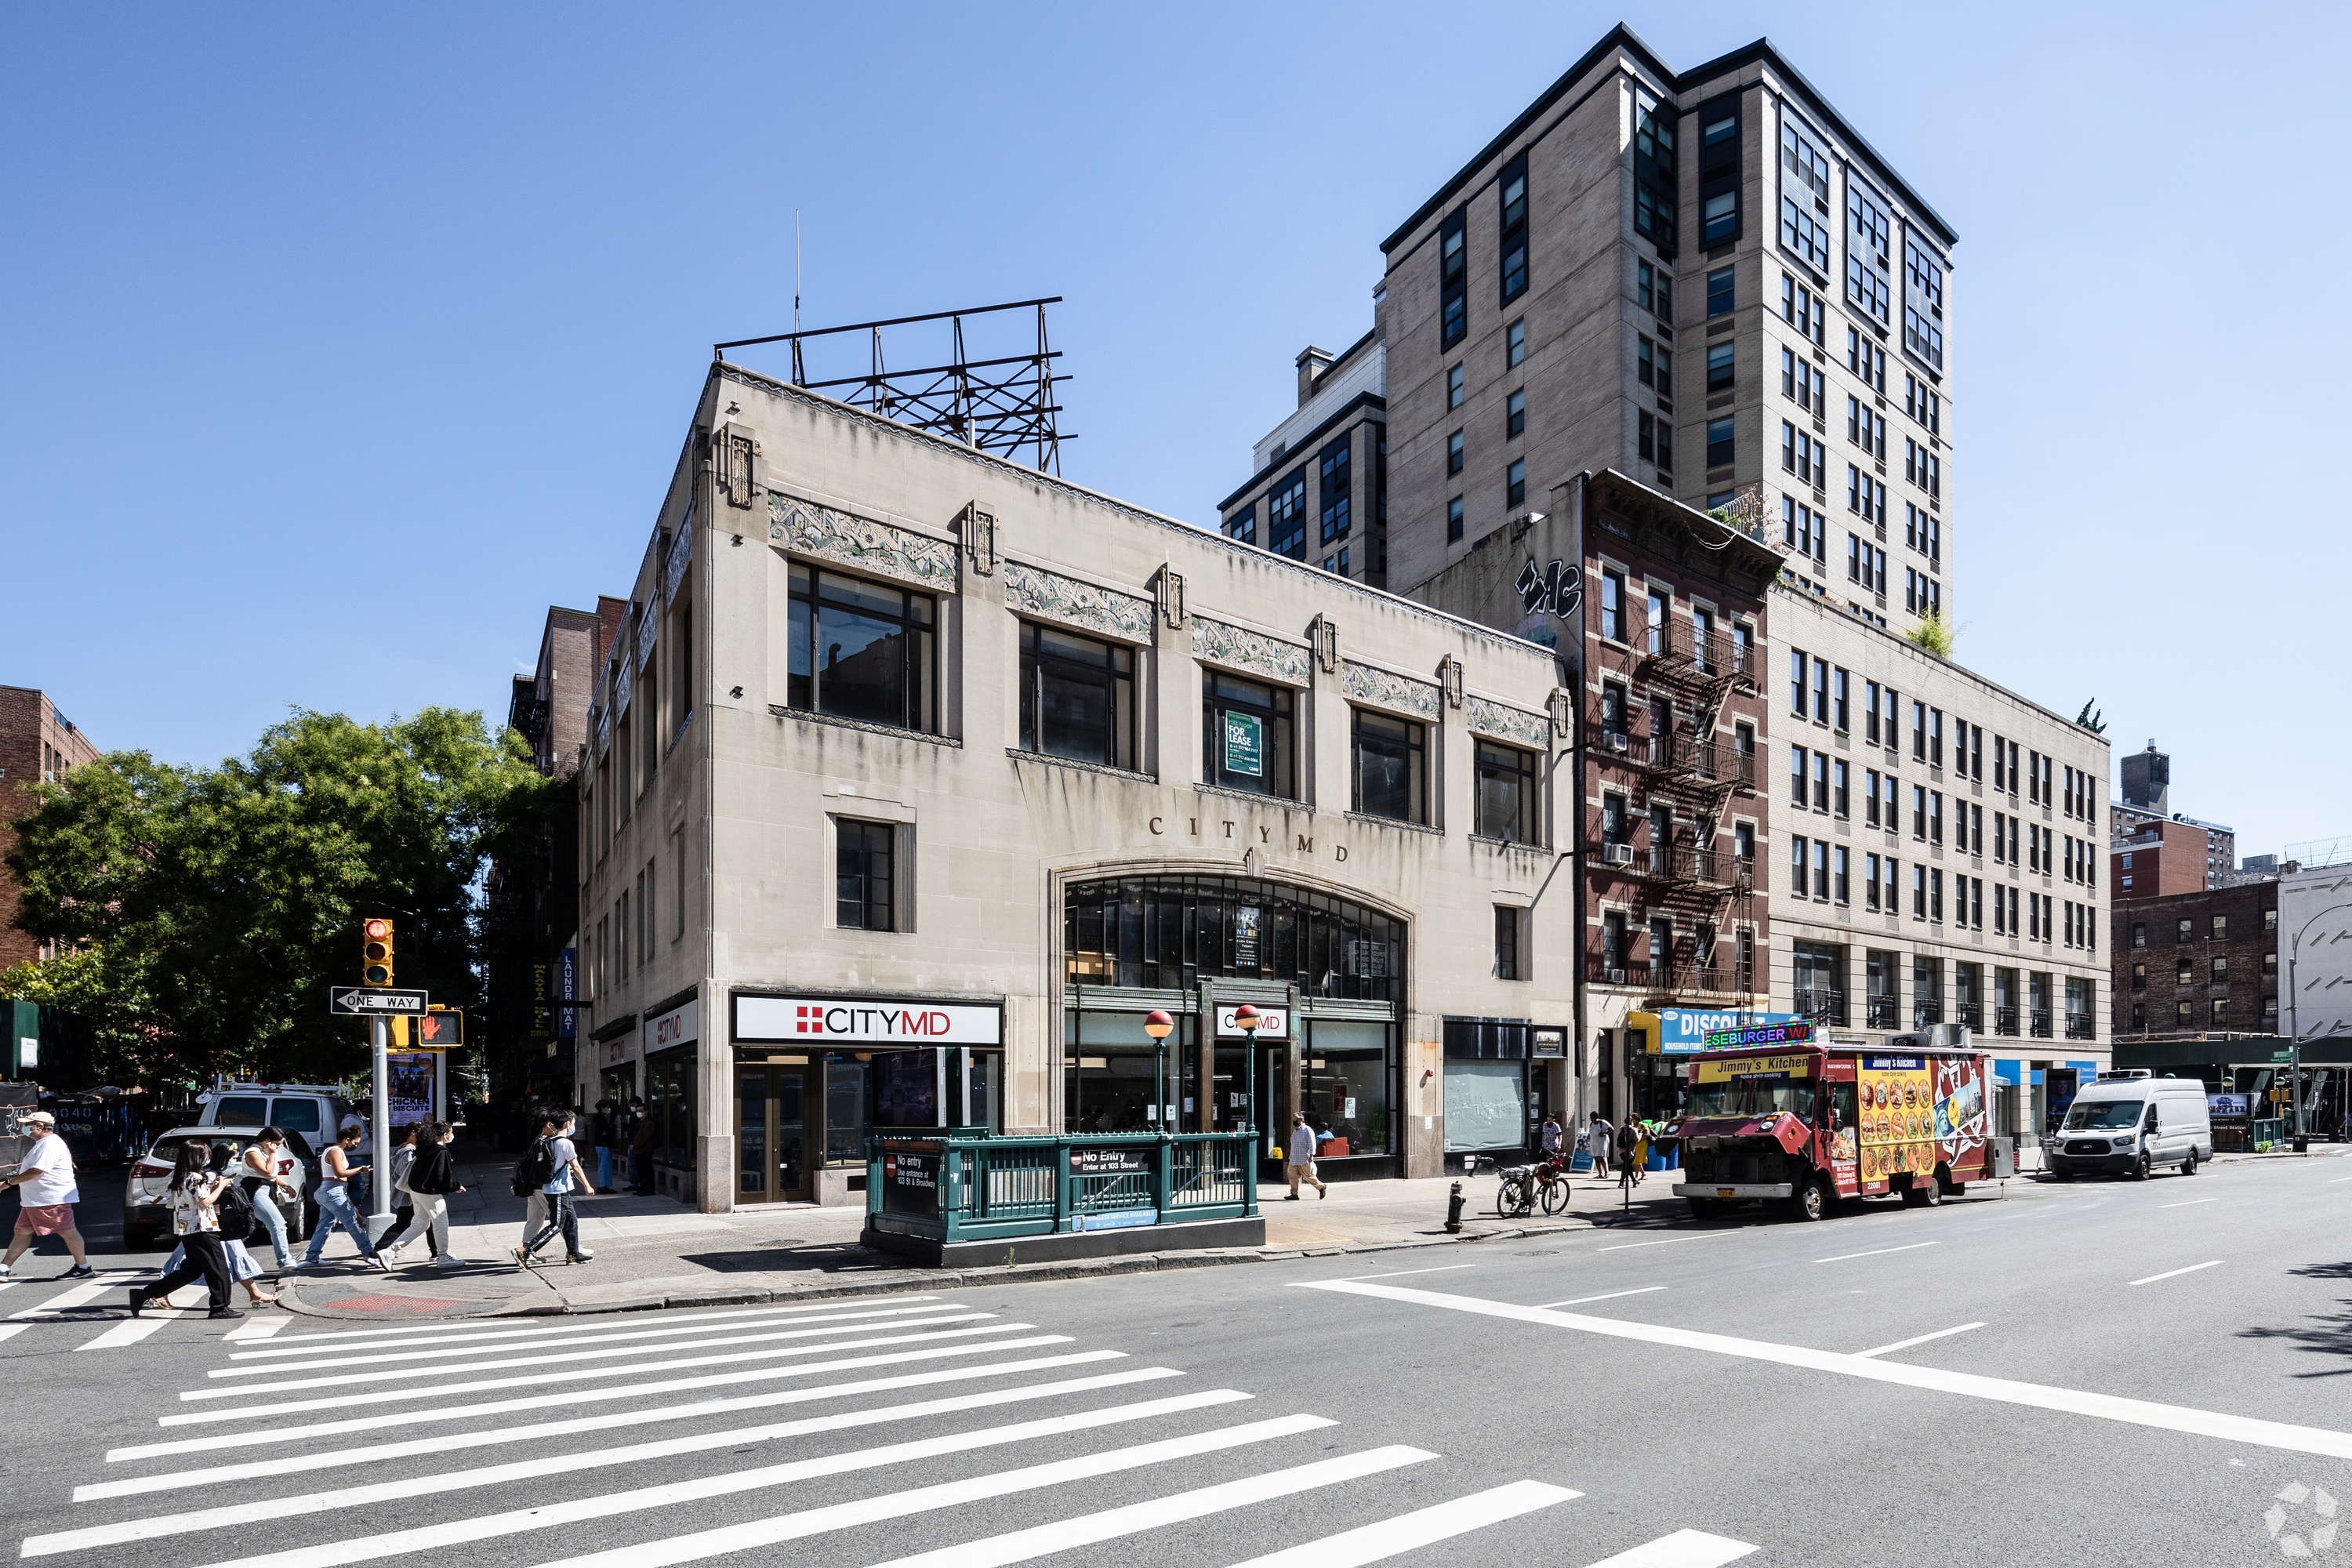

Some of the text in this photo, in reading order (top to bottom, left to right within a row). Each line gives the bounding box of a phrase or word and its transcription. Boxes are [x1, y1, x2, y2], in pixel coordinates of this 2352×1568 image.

[1229, 724, 1245, 736] FOR
[1229, 733, 1252, 746] LEASE
[564, 955, 573, 1029] LAUNDRMAT
[347, 996, 415, 1007] ONE WAY
[825, 1007, 950, 1036] CITYMD
[1225, 1014, 1279, 1029] CMD
[662, 1014, 681, 1044] CITYMD
[1664, 1042, 1702, 1051] HOUSEHOLD ITEMS
[1717, 1056, 1809, 1073] Jimmy's Kitchen
[1872, 1055, 1917, 1070] Jimmy's Kitchen
[897, 1154, 922, 1169] No entry
[1082, 1150, 1126, 1163] No Entry
[897, 1168, 906, 1177] Use
[906, 1170, 924, 1178] entrance
[906, 1177, 911, 1185] St
[911, 1178, 916, 1186] &
[916, 1178, 936, 1189] Broadway
